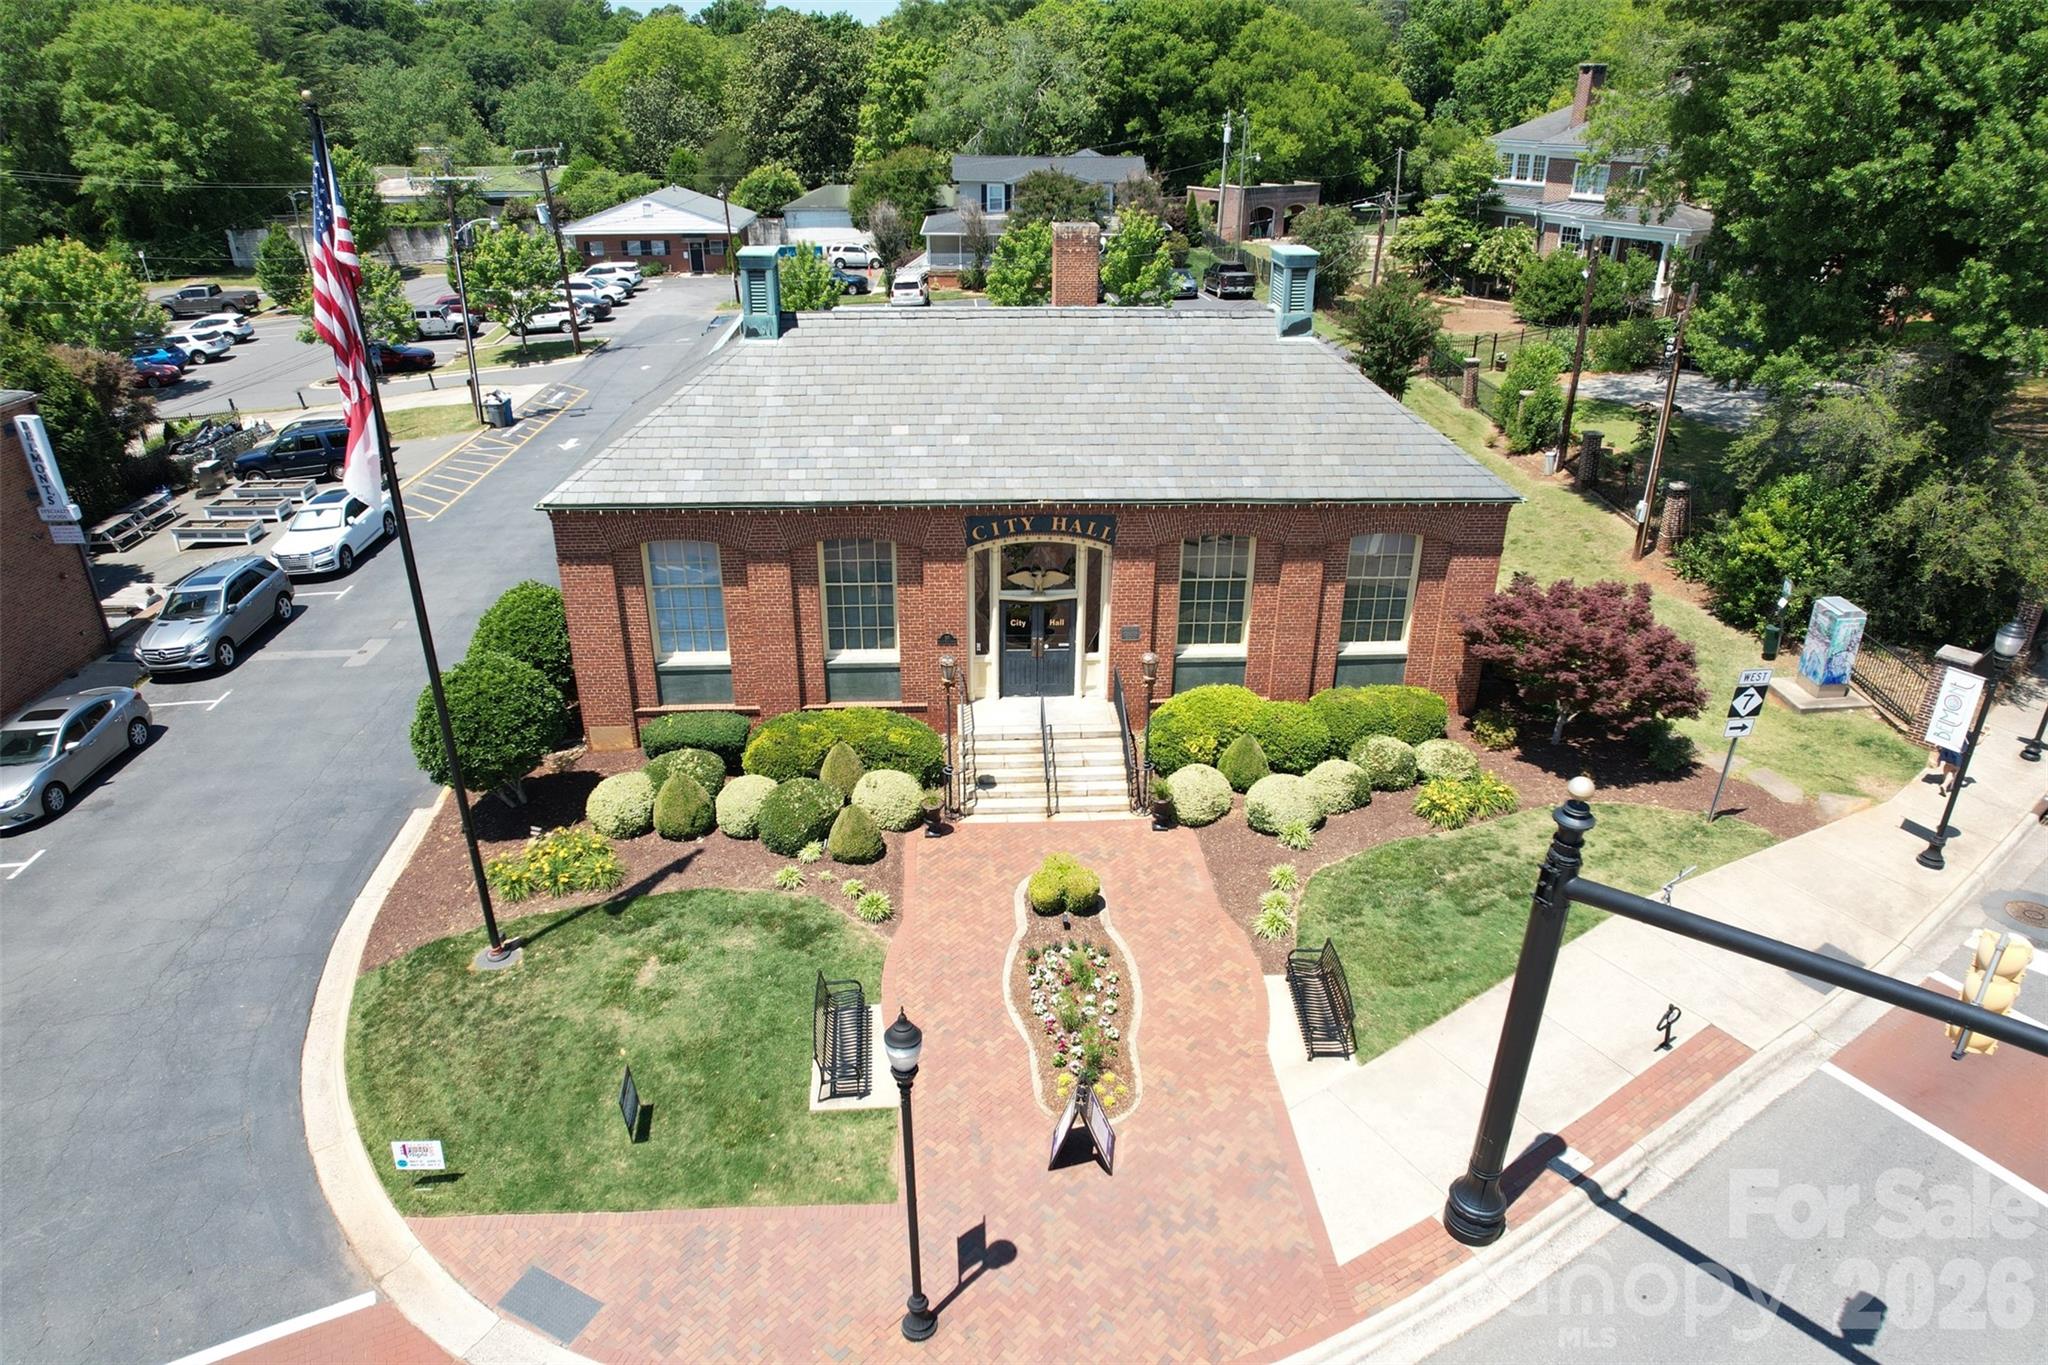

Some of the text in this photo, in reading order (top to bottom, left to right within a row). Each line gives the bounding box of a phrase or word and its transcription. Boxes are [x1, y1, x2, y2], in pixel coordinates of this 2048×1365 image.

[971, 516, 1114, 542] CITY HALL
[1010, 619, 1065, 629] City Hall
[1743, 672, 1768, 682] WEST
[1743, 693, 1755, 710] 7
